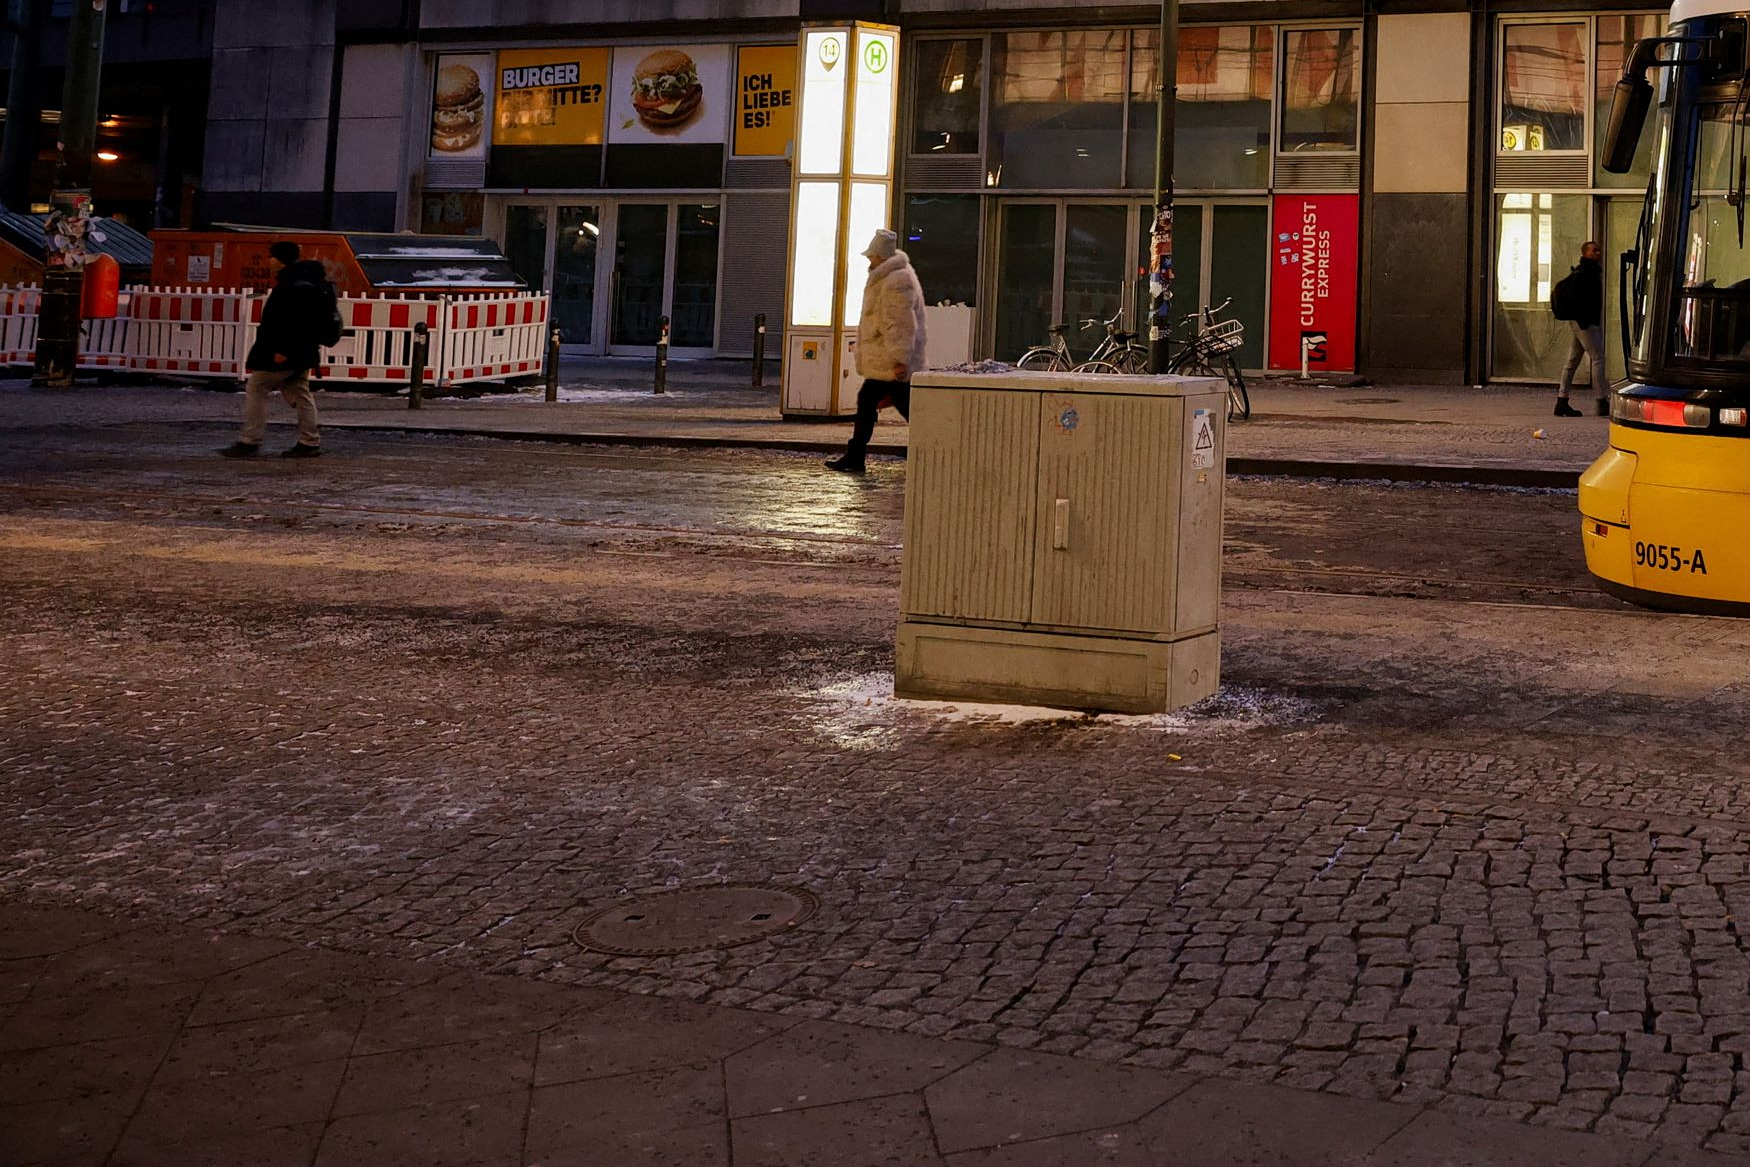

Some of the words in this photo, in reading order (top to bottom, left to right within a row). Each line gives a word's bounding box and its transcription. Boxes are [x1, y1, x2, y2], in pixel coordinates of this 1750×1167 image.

[870, 47, 882, 67] H
[503, 63, 579, 89] BURGER
[743, 73, 772, 93] ICH
[743, 89, 792, 111] LIEBE
[743, 111, 771, 130] ES!
[1300, 202, 1318, 327] CURRYWURST
[1317, 230, 1331, 298] EXPRESS
[1635, 541, 1708, 575] 9055-A
